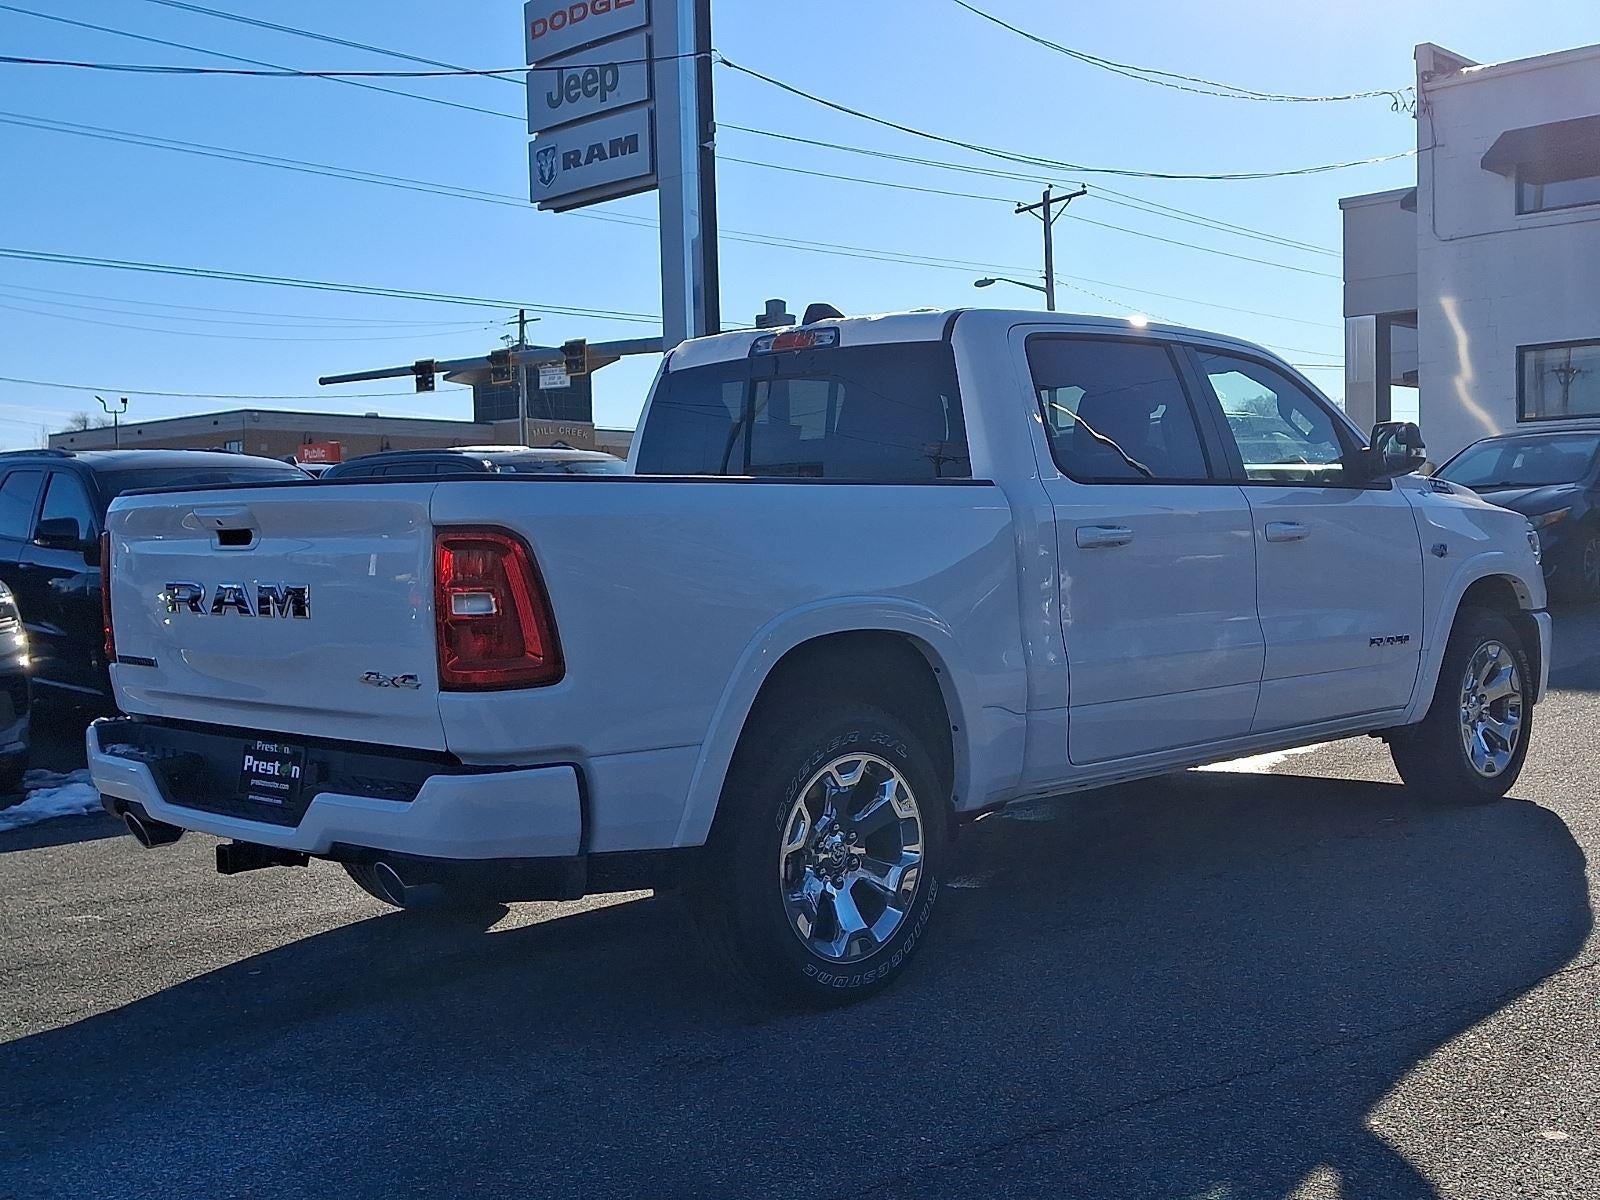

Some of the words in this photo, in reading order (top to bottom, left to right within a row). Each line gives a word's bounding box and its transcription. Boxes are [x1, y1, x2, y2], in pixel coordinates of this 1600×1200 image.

[546, 63, 620, 109] Jeep
[562, 133, 639, 171] RAM
[533, 426, 554, 437] MILL
[559, 426, 588, 439] CREEK
[304, 449, 326, 459] Public
[164, 580, 311, 619] RAM
[802, 876, 939, 988] BRIDGESTONE
